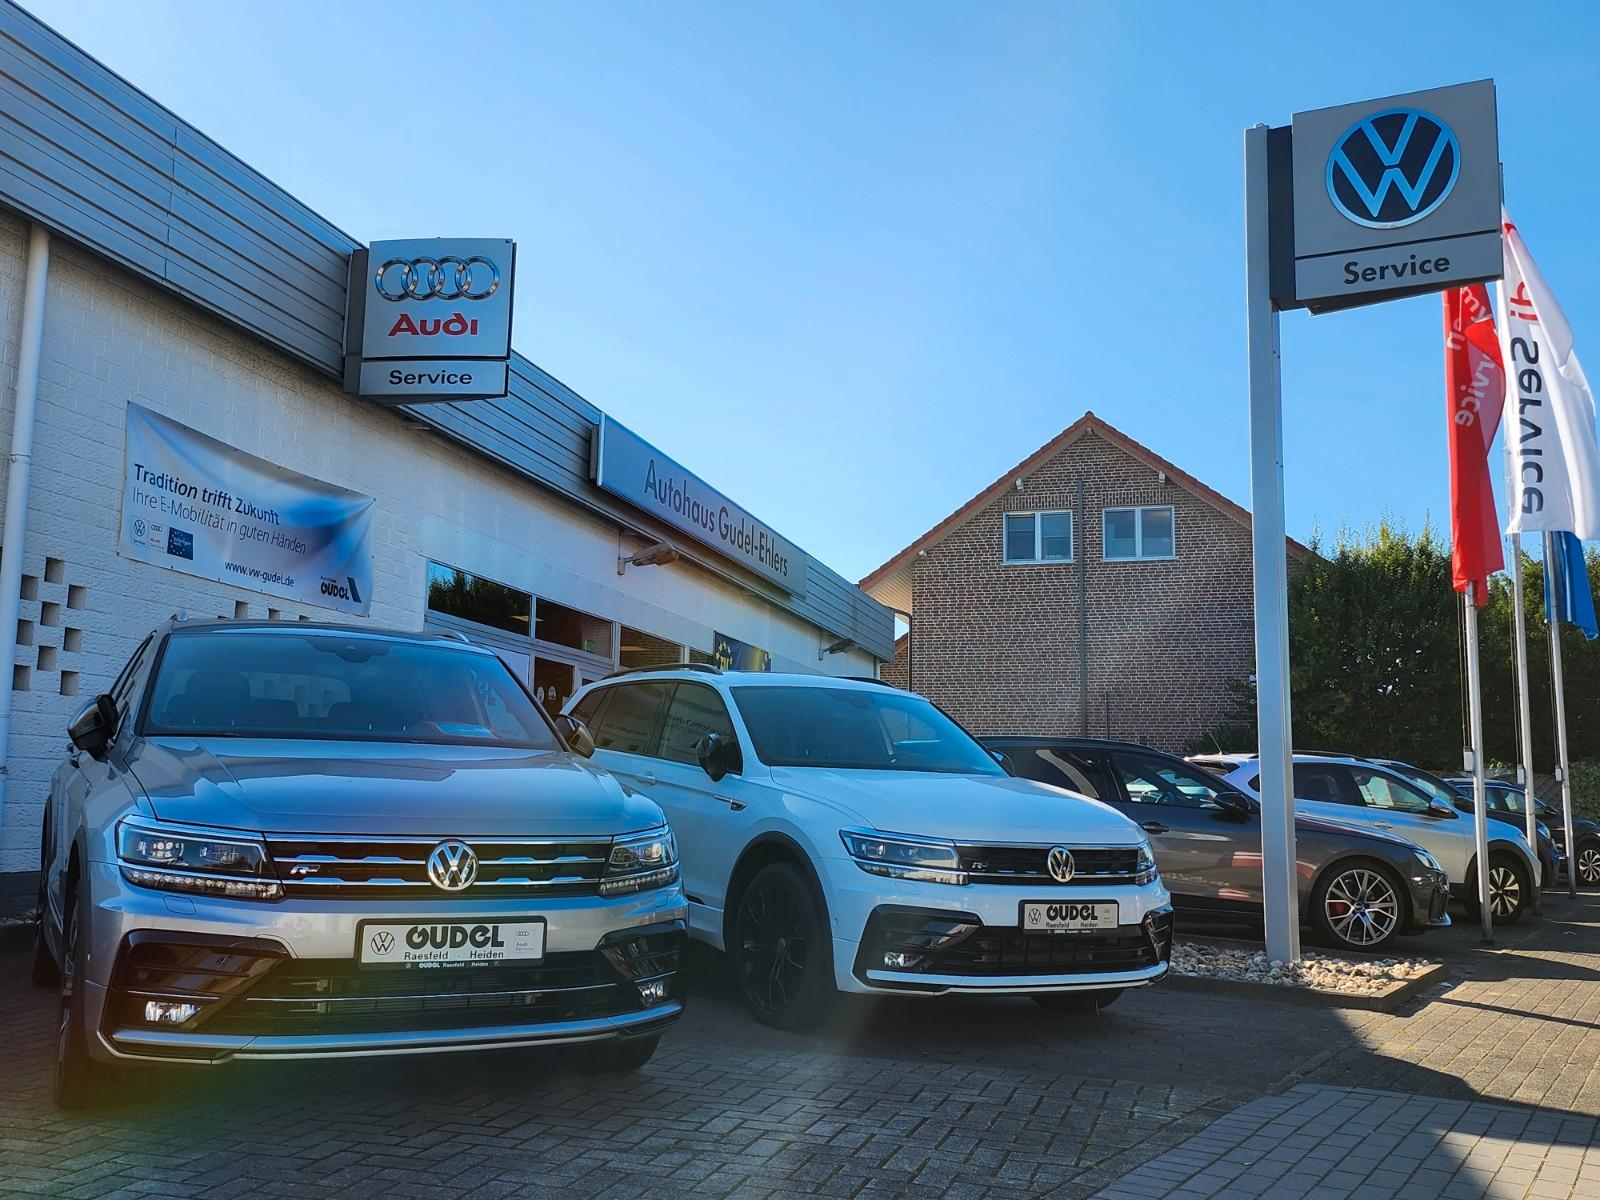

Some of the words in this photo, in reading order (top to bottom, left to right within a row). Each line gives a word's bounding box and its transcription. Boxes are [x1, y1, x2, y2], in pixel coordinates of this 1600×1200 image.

[1343, 254, 1450, 285] Service
[388, 312, 479, 337] Audi
[389, 369, 473, 385] Service
[134, 463, 198, 500] Tradition
[201, 487, 232, 511] trifft
[235, 497, 280, 526] Zukunft
[132, 487, 158, 509] Ihre
[160, 495, 225, 531] E-Mobilität
[226, 517, 238, 533] in
[239, 524, 270, 541] guten
[271, 530, 306, 555] Händen
[644, 458, 716, 533] Autohaus
[718, 505, 789, 577] Gudel-Ehlers
[224, 561, 295, 587] www.vw-gudel.de
[403, 951, 449, 961] Raesfeld
[469, 950, 504, 960] Heiden
